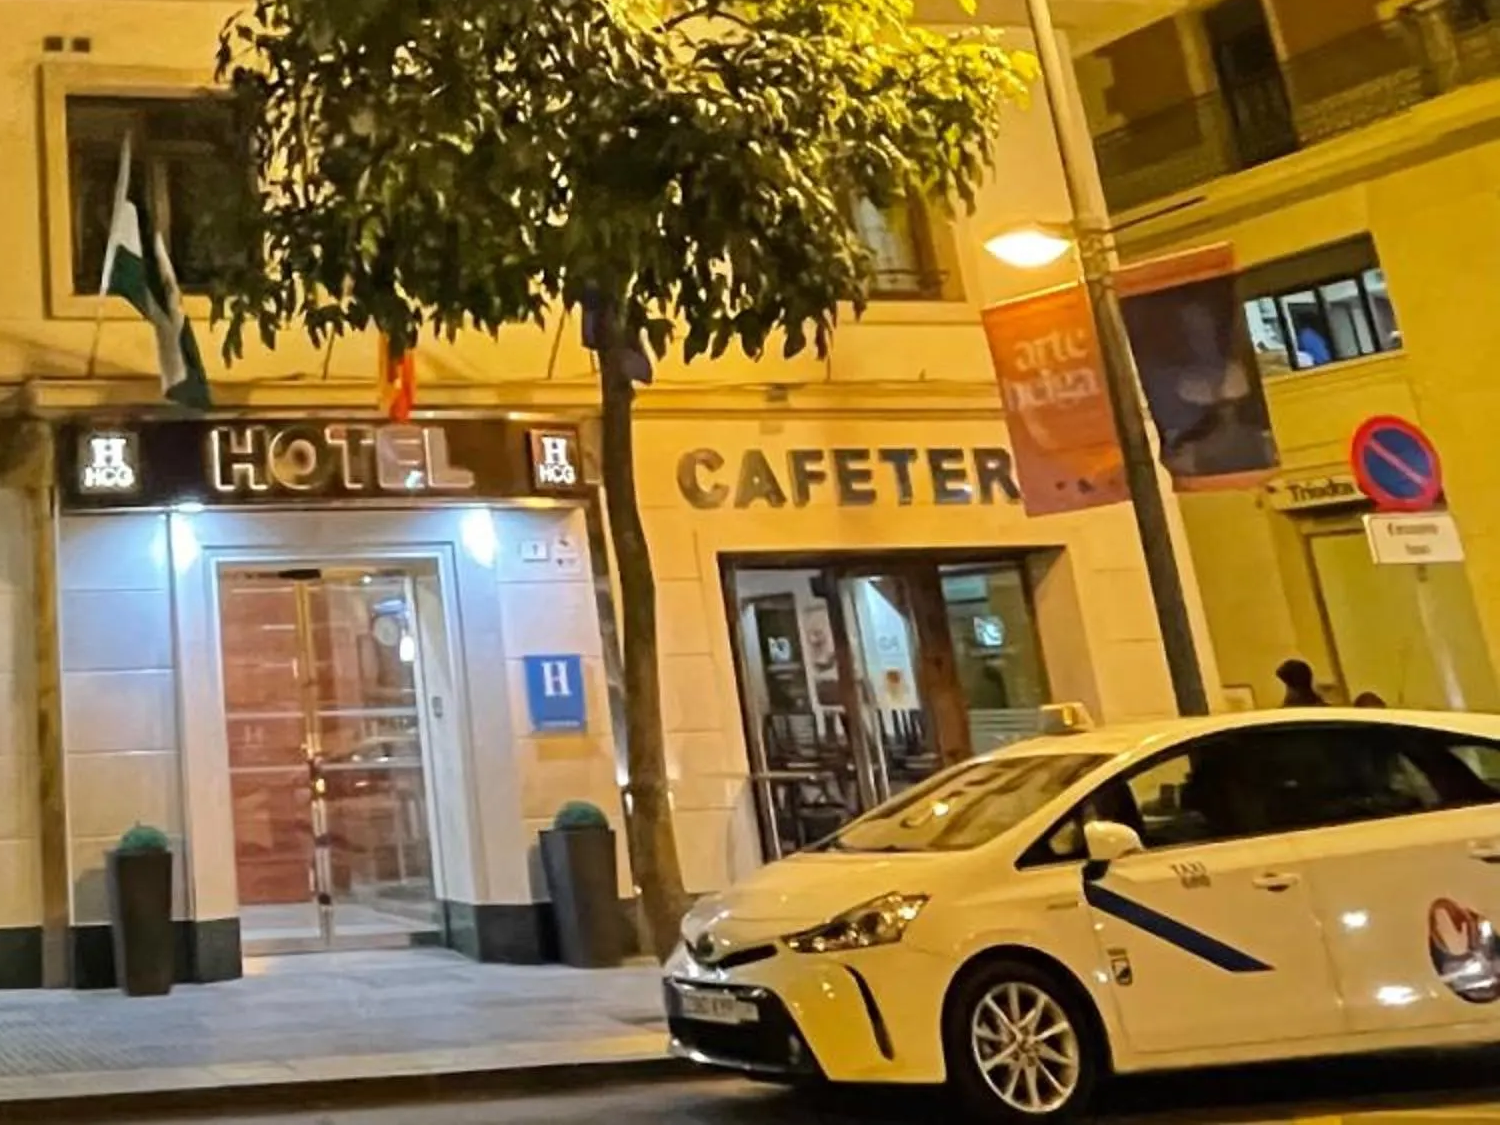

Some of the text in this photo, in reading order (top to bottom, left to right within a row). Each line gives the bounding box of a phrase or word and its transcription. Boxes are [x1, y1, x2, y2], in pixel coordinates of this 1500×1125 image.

[211, 424, 475, 490] HOTEL
[84, 466, 134, 487] HCG
[539, 465, 576, 483] HCG
[541, 660, 572, 697] H
[1168, 861, 1207, 875] TAXI
